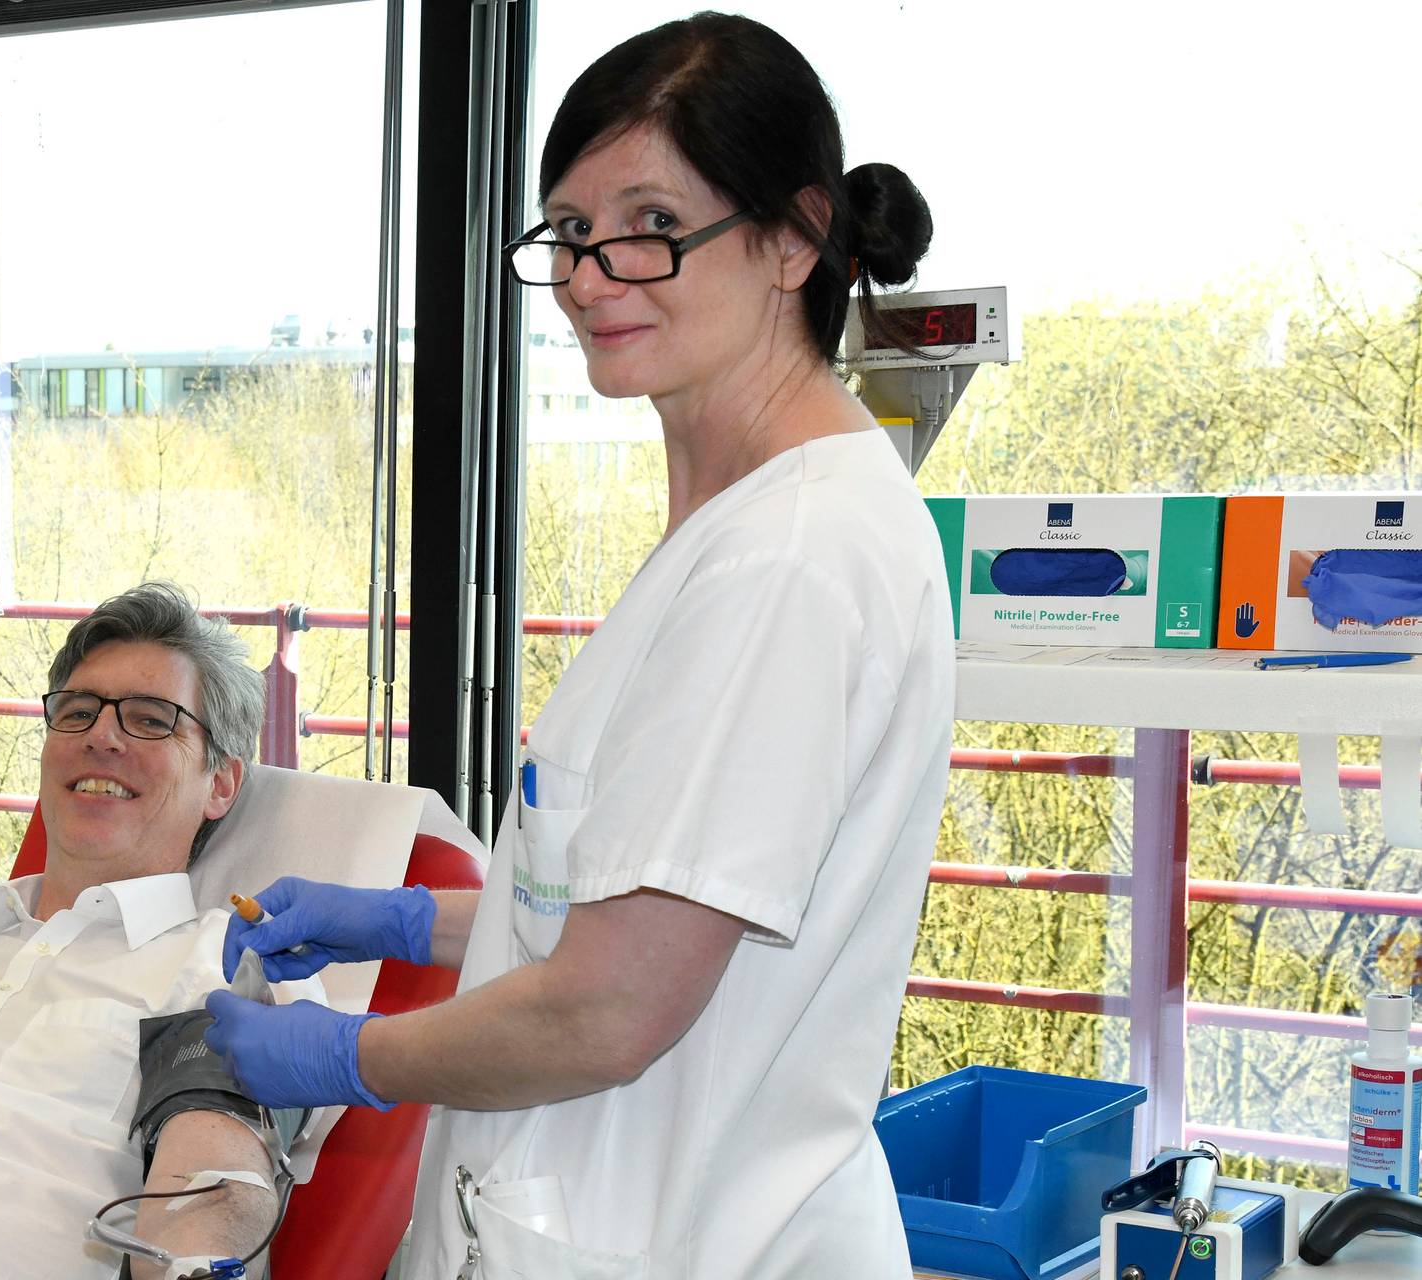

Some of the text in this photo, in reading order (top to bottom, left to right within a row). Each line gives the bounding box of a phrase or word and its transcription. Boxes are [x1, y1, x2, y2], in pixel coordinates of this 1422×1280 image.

[1039, 530, 1082, 541] Classic
[1365, 530, 1414, 541] Classic
[994, 610, 1120, 622] Nitrile Powder-Free
[1179, 606, 1188, 618] S
[1075, 623, 1097, 631] Gloves
[1332, 629, 1358, 637] Medical
[1359, 629, 1402, 637] Examination
